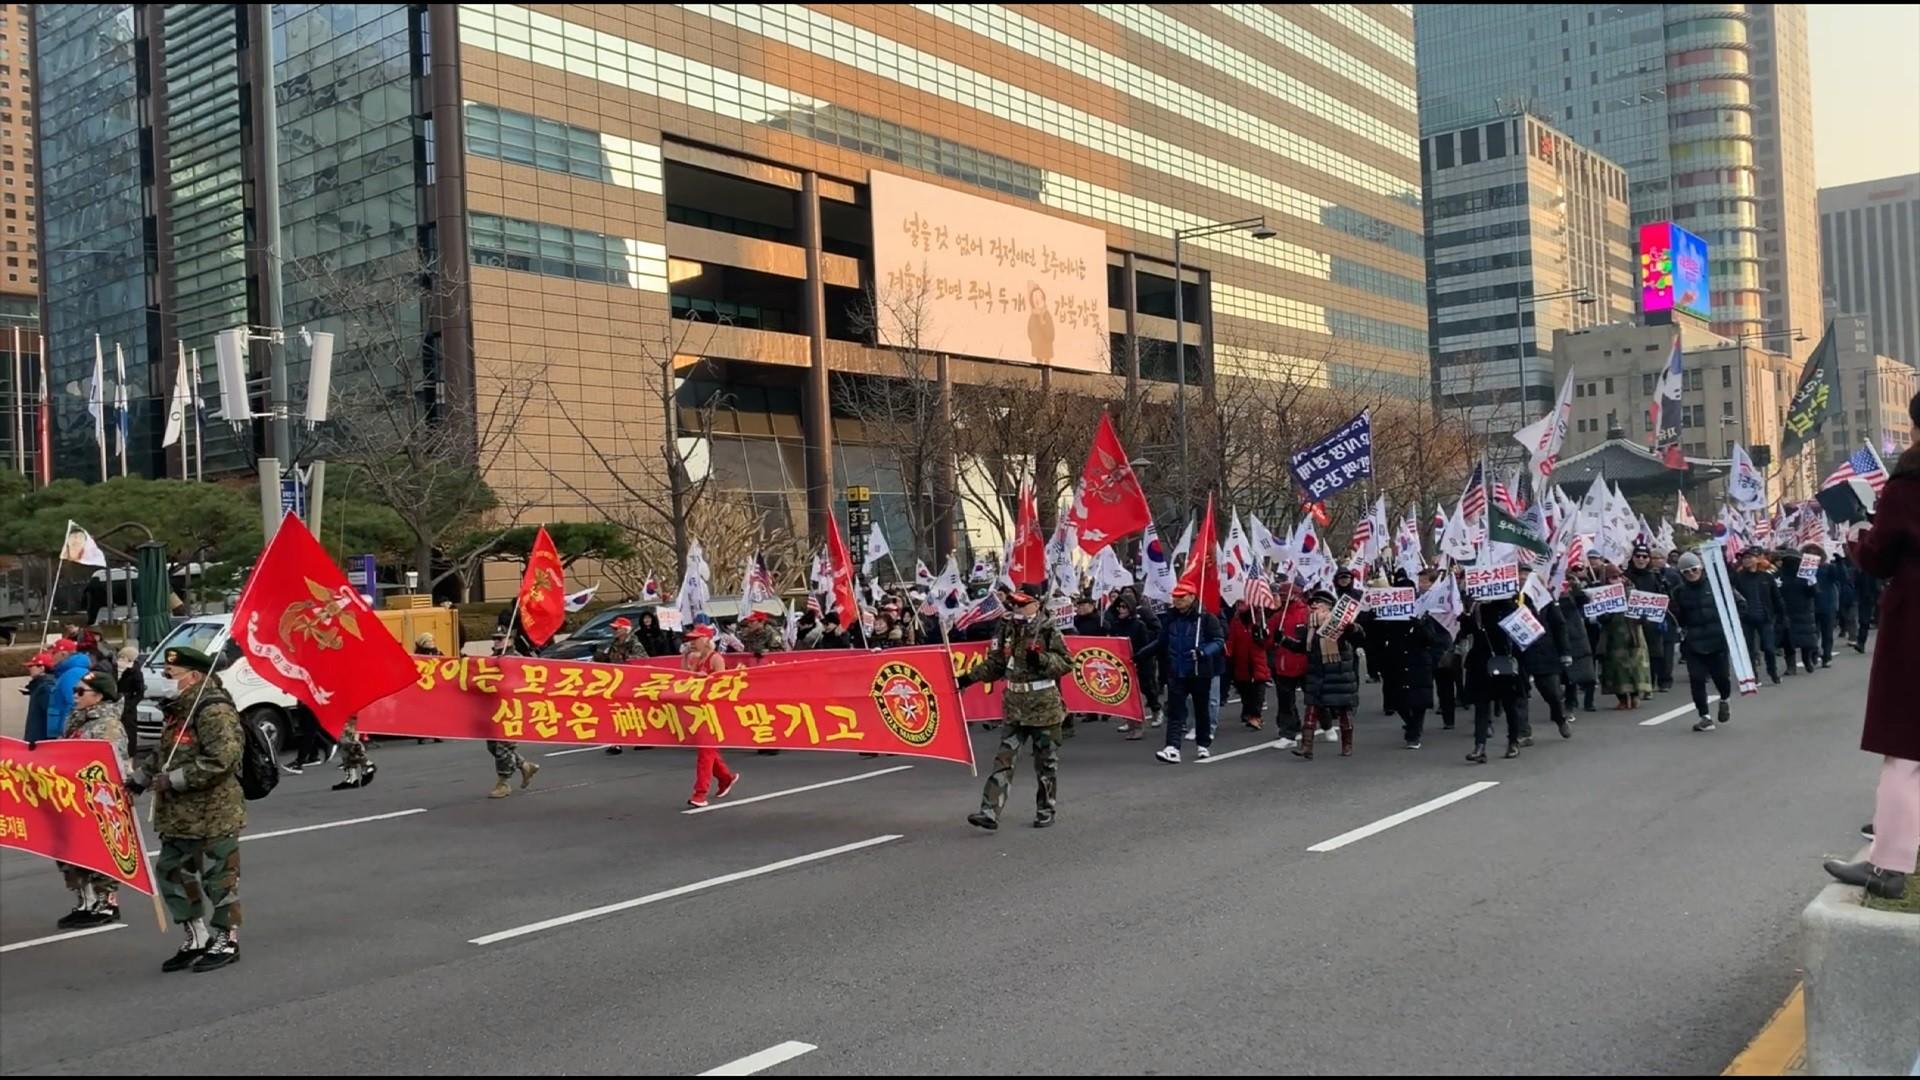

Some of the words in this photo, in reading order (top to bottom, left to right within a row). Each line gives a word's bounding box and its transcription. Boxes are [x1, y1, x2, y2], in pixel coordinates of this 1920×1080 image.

[903, 211, 931, 252] 넣을
[935, 224, 948, 250] 것
[956, 233, 983, 256] 없어
[990, 236, 1036, 268] 걱정이던
[1041, 244, 1086, 280] 호주머니는
[936, 278, 963, 301] 되면
[968, 281, 993, 313] 주먹
[999, 288, 1009, 314] 두
[1012, 293, 1026, 313] 개
[1467, 564, 1517, 585] 공수처를
[1467, 580, 1519, 600] 반대한다
[1371, 590, 1413, 606] 공수처를
[514, 664, 624, 700] 모조리
[633, 663, 749, 701] 죽여라
[492, 698, 599, 740] 심판은
[608, 702, 725, 743] 神에게
[734, 703, 864, 745] 맡기고
